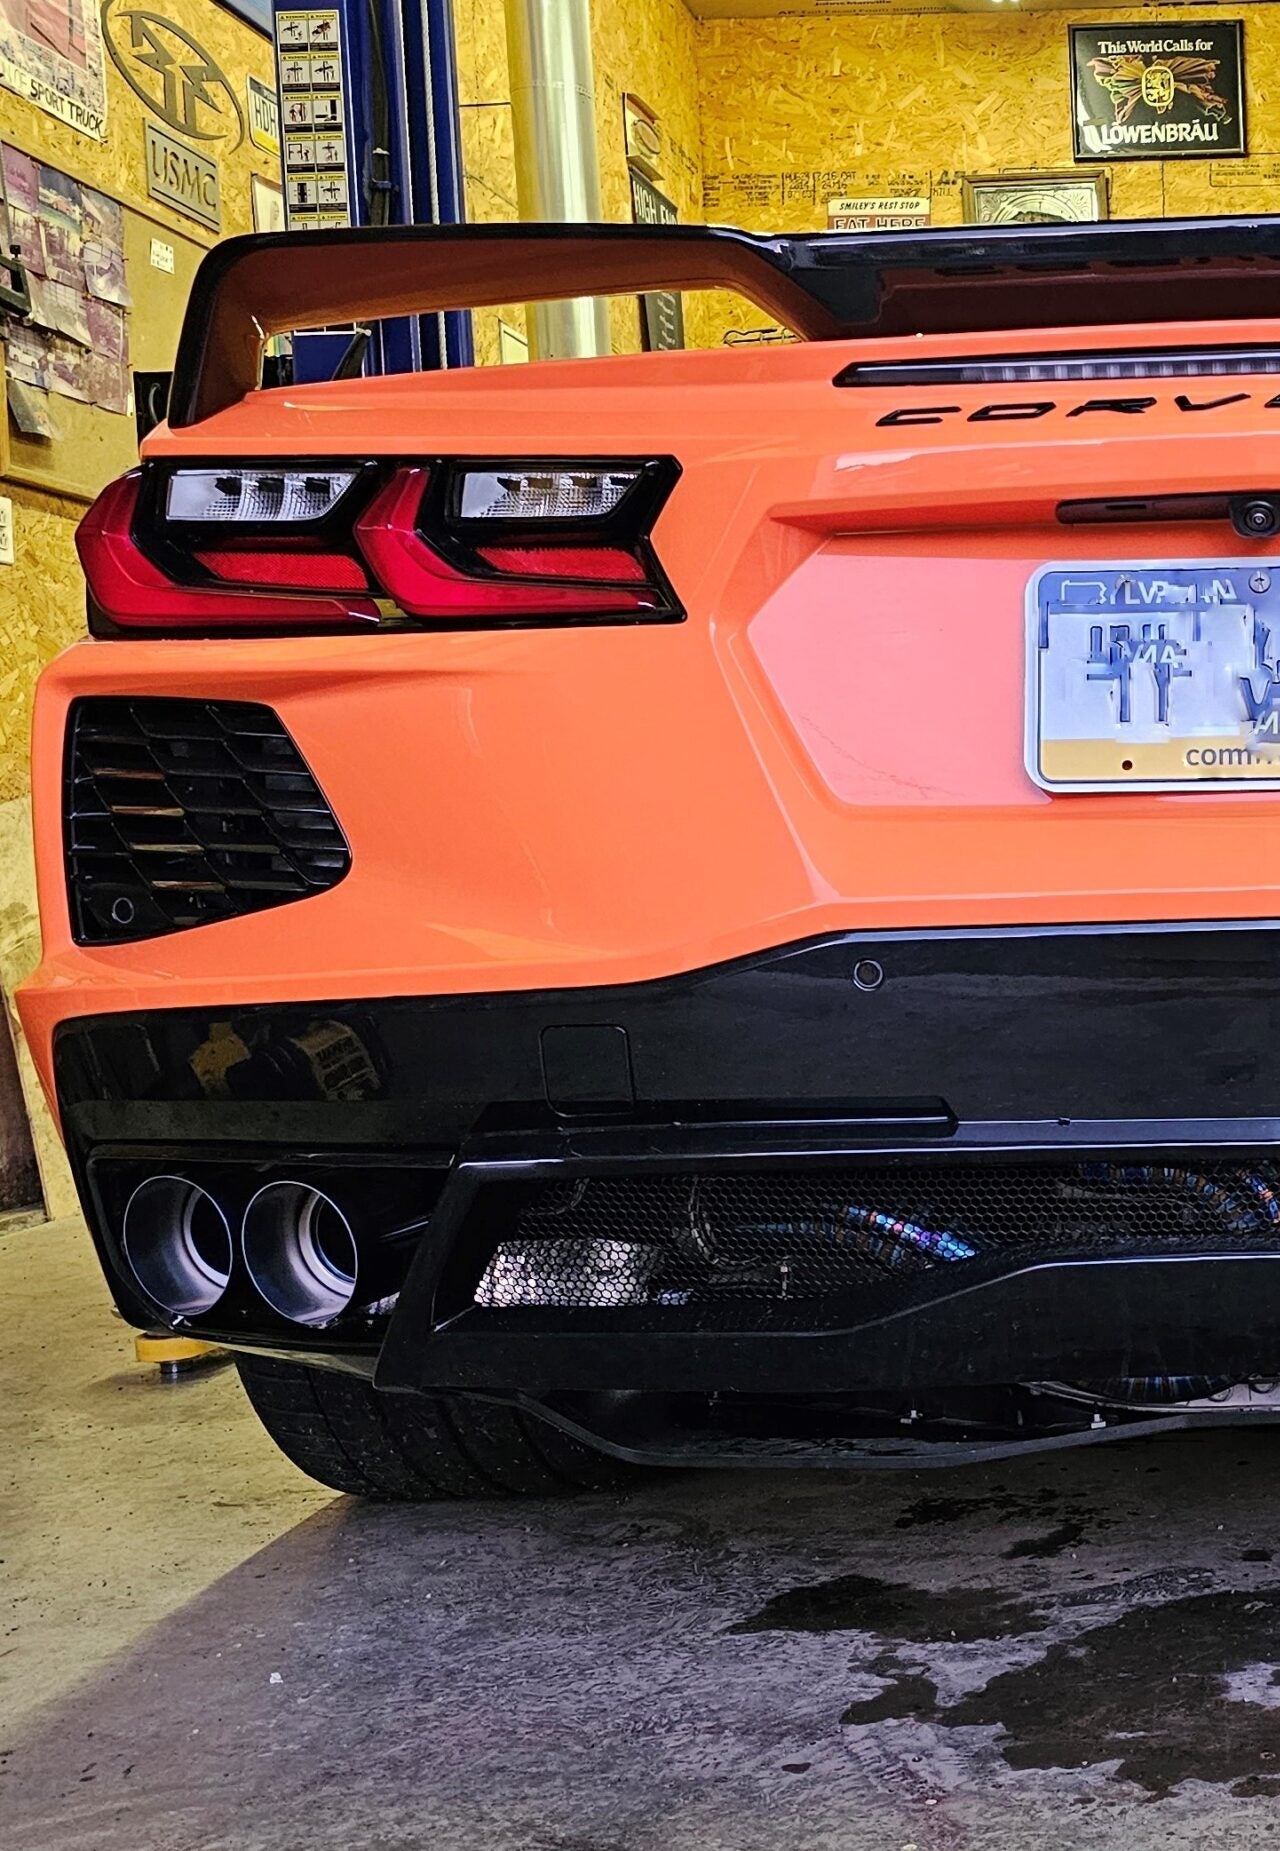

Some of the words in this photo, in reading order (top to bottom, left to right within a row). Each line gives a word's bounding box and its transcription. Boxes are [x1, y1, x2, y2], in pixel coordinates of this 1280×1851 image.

[1098, 41, 1126, 54] This
[1126, 40, 1163, 53] World
[1163, 39, 1194, 52] Calls
[1195, 38, 1213, 51] for
[30, 79, 65, 114] SPORT
[67, 101, 104, 137] TRUCK
[1101, 119, 1219, 145] LÖWENBRÄU
[152, 140, 217, 211] USMC
[633, 180, 657, 224] HIGH
[840, 202, 876, 210] SMILEY'S
[834, 217, 870, 230] EAT
[875, 216, 926, 229] HERE
